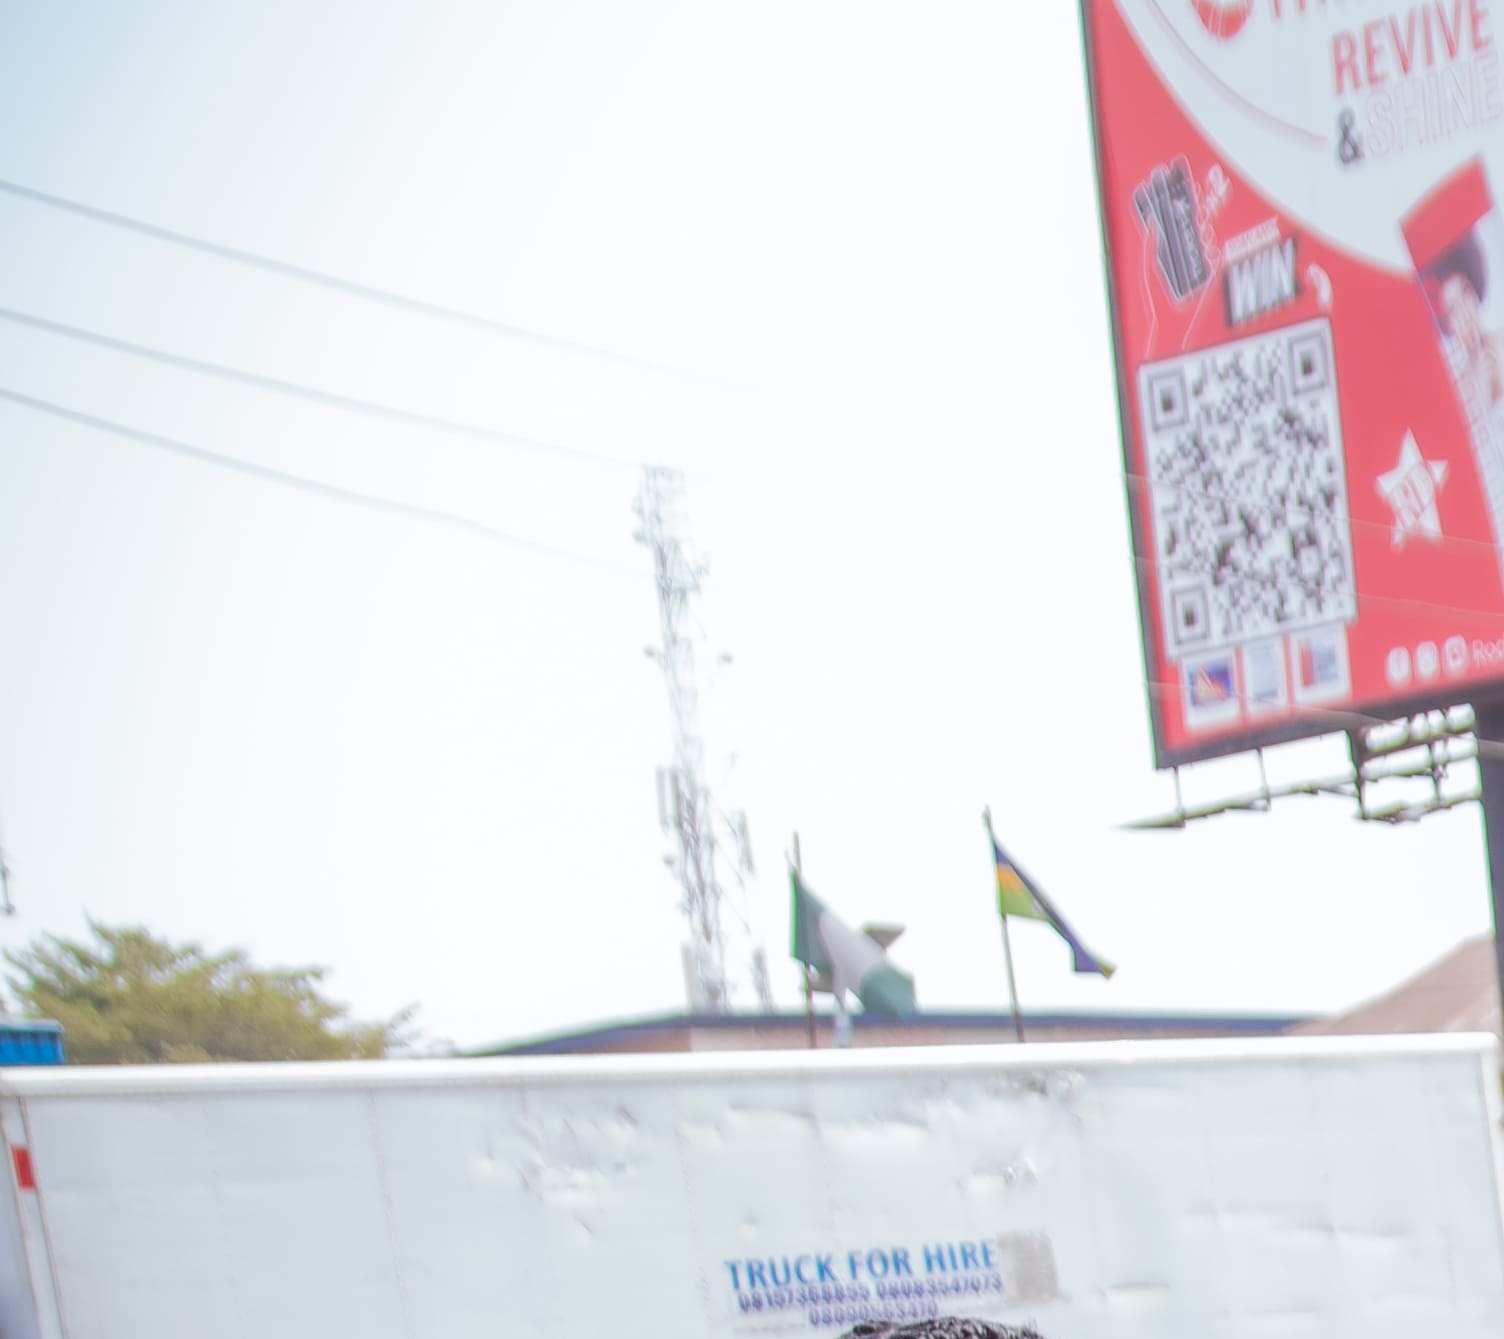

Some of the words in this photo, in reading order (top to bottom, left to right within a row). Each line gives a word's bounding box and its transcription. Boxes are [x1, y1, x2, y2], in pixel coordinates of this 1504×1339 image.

[1331, 0, 1494, 96] REVIVE
[1336, 108, 1366, 164] &
[1367, 54, 1504, 156] SHINE
[1229, 237, 1298, 326] WIN
[724, 1252, 836, 1292] TRUCK
[846, 1245, 914, 1281] FOR
[921, 1238, 998, 1274] HIRE
